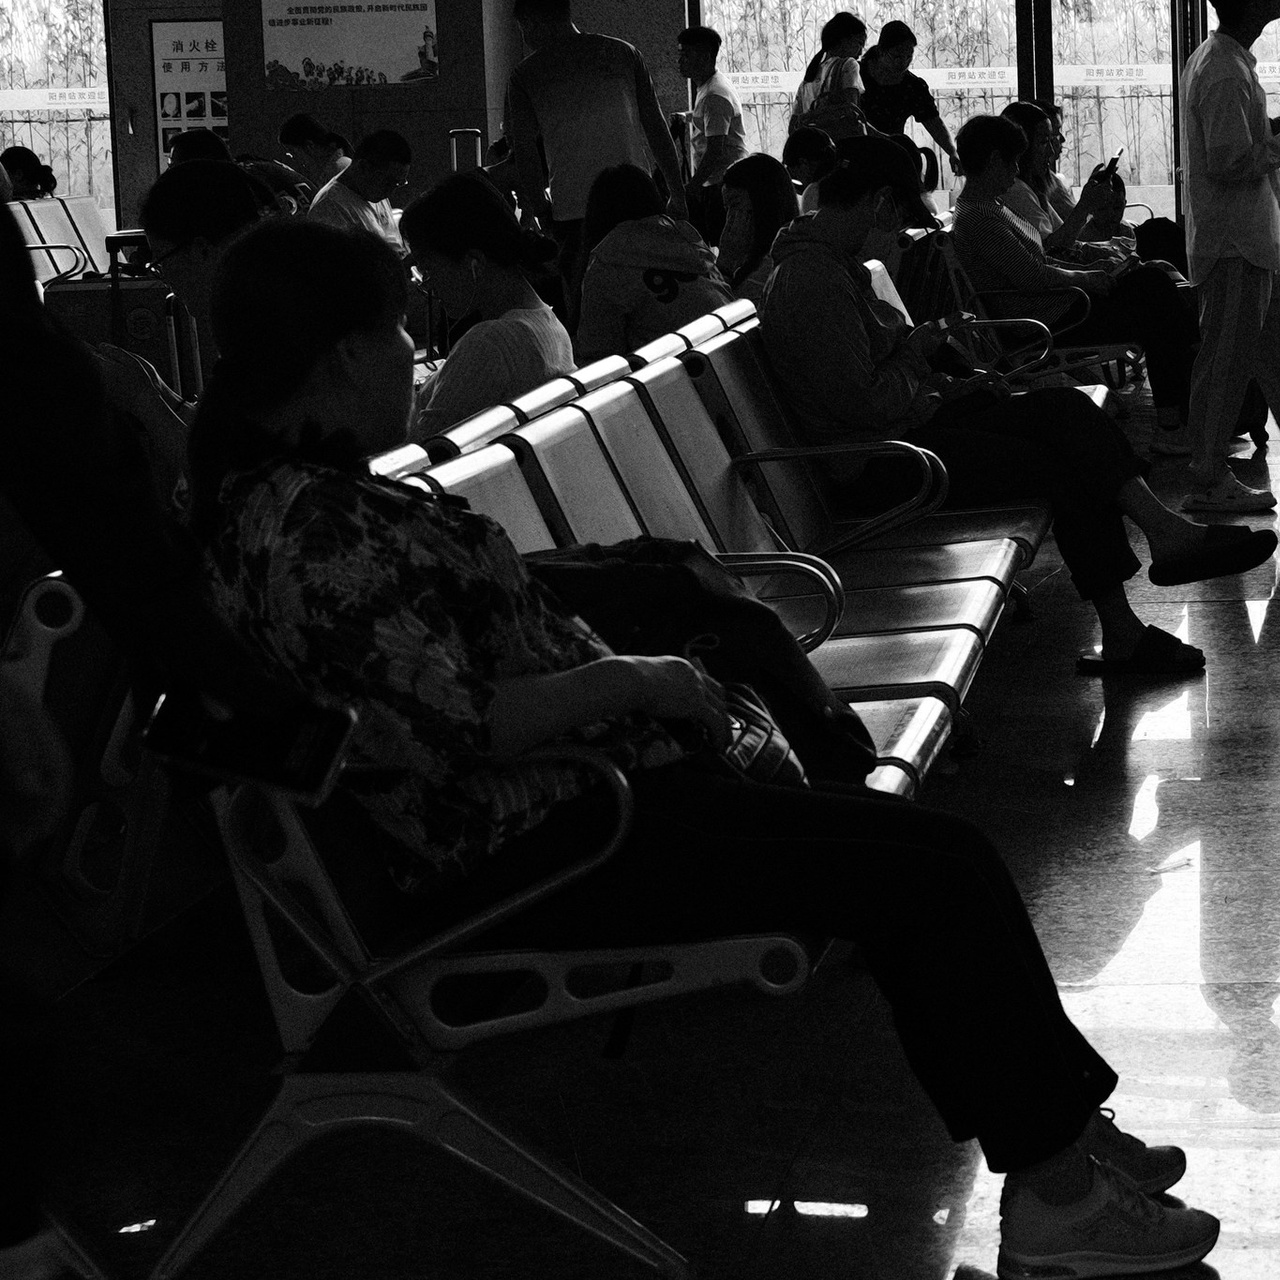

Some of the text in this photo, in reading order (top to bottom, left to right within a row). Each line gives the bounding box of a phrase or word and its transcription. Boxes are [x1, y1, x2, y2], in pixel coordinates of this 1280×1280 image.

[172, 39, 218, 53] 消火栓
[162, 61, 226, 73] 使用方法
[947, 71, 1006, 80] 阳朔站欢迎您
[1085, 68, 1144, 77] 阳朔站欢迎您
[729, 75, 780, 84] 朔站欢迎您
[48, 91, 106, 101] 阳朔站欢迎您
